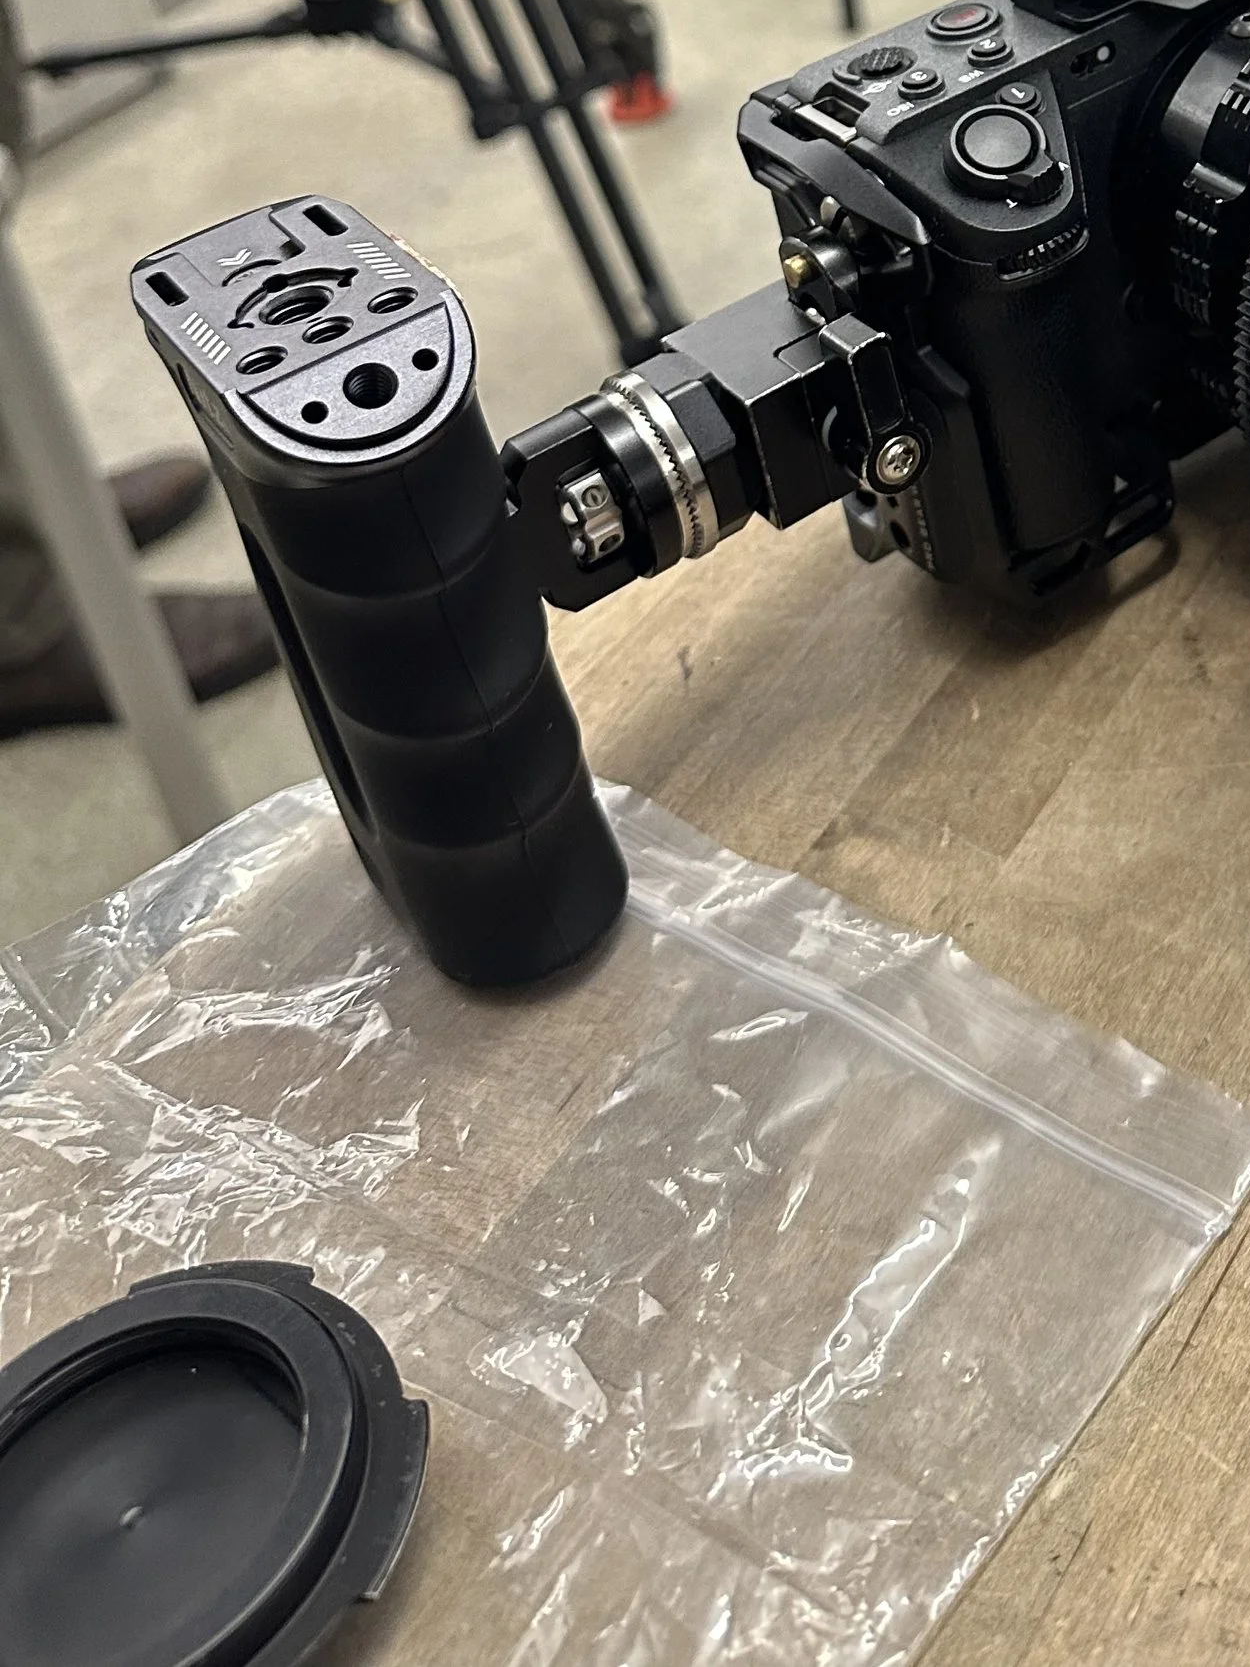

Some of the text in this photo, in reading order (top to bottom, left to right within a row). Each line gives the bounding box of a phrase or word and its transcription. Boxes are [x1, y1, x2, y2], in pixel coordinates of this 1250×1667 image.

[910, 71, 928, 82] 3
[1010, 87, 1026, 100] 1
[886, 101, 916, 117] ISO
